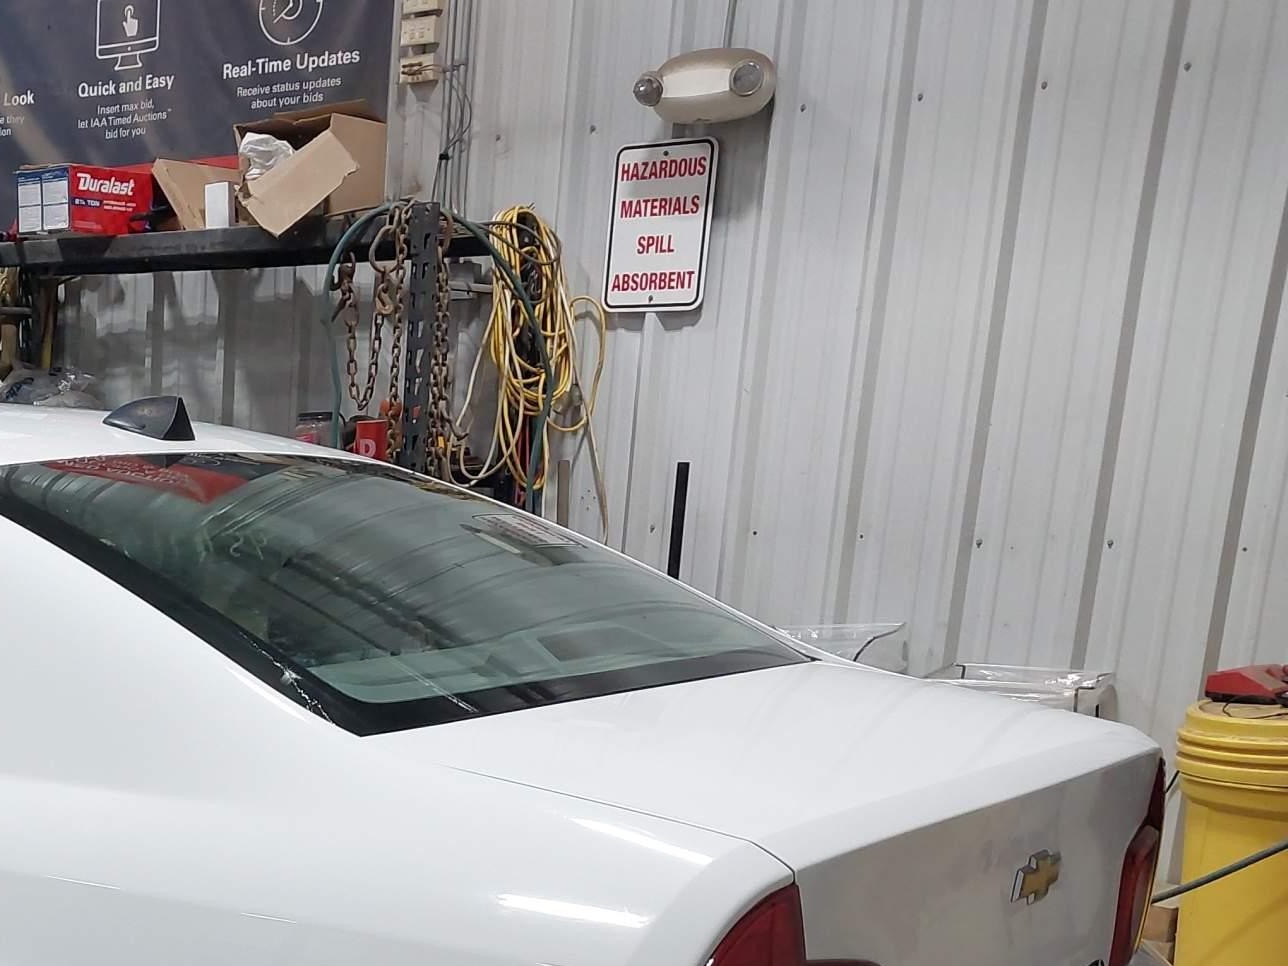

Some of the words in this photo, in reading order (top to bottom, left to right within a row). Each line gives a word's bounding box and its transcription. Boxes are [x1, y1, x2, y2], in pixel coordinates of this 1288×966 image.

[223, 58, 291, 79] Real-Time
[296, 50, 360, 72] Updates
[78, 80, 116, 97] Quick
[118, 76, 142, 93] and
[145, 74, 174, 90] Easy
[237, 85, 270, 97] Receive
[272, 81, 300, 93] status
[302, 76, 342, 92] updates
[3, 90, 35, 106] Look
[97, 105, 120, 114] Insert
[121, 103, 139, 112] max
[251, 98, 277, 109] about
[279, 95, 300, 107] your
[303, 92, 324, 103] bids
[78, 119, 88, 128] let
[91, 118, 107, 127] IAA
[108, 115, 132, 126] Timed
[105, 128, 118, 139] bid
[119, 127, 130, 137] for
[131, 127, 146, 138] you
[621, 156, 707, 181] HAZARDOUS
[77, 172, 135, 196] Duralast
[620, 195, 700, 219] MATERIALS
[636, 234, 675, 254] SPILL
[611, 271, 695, 292] ABSORBENT
